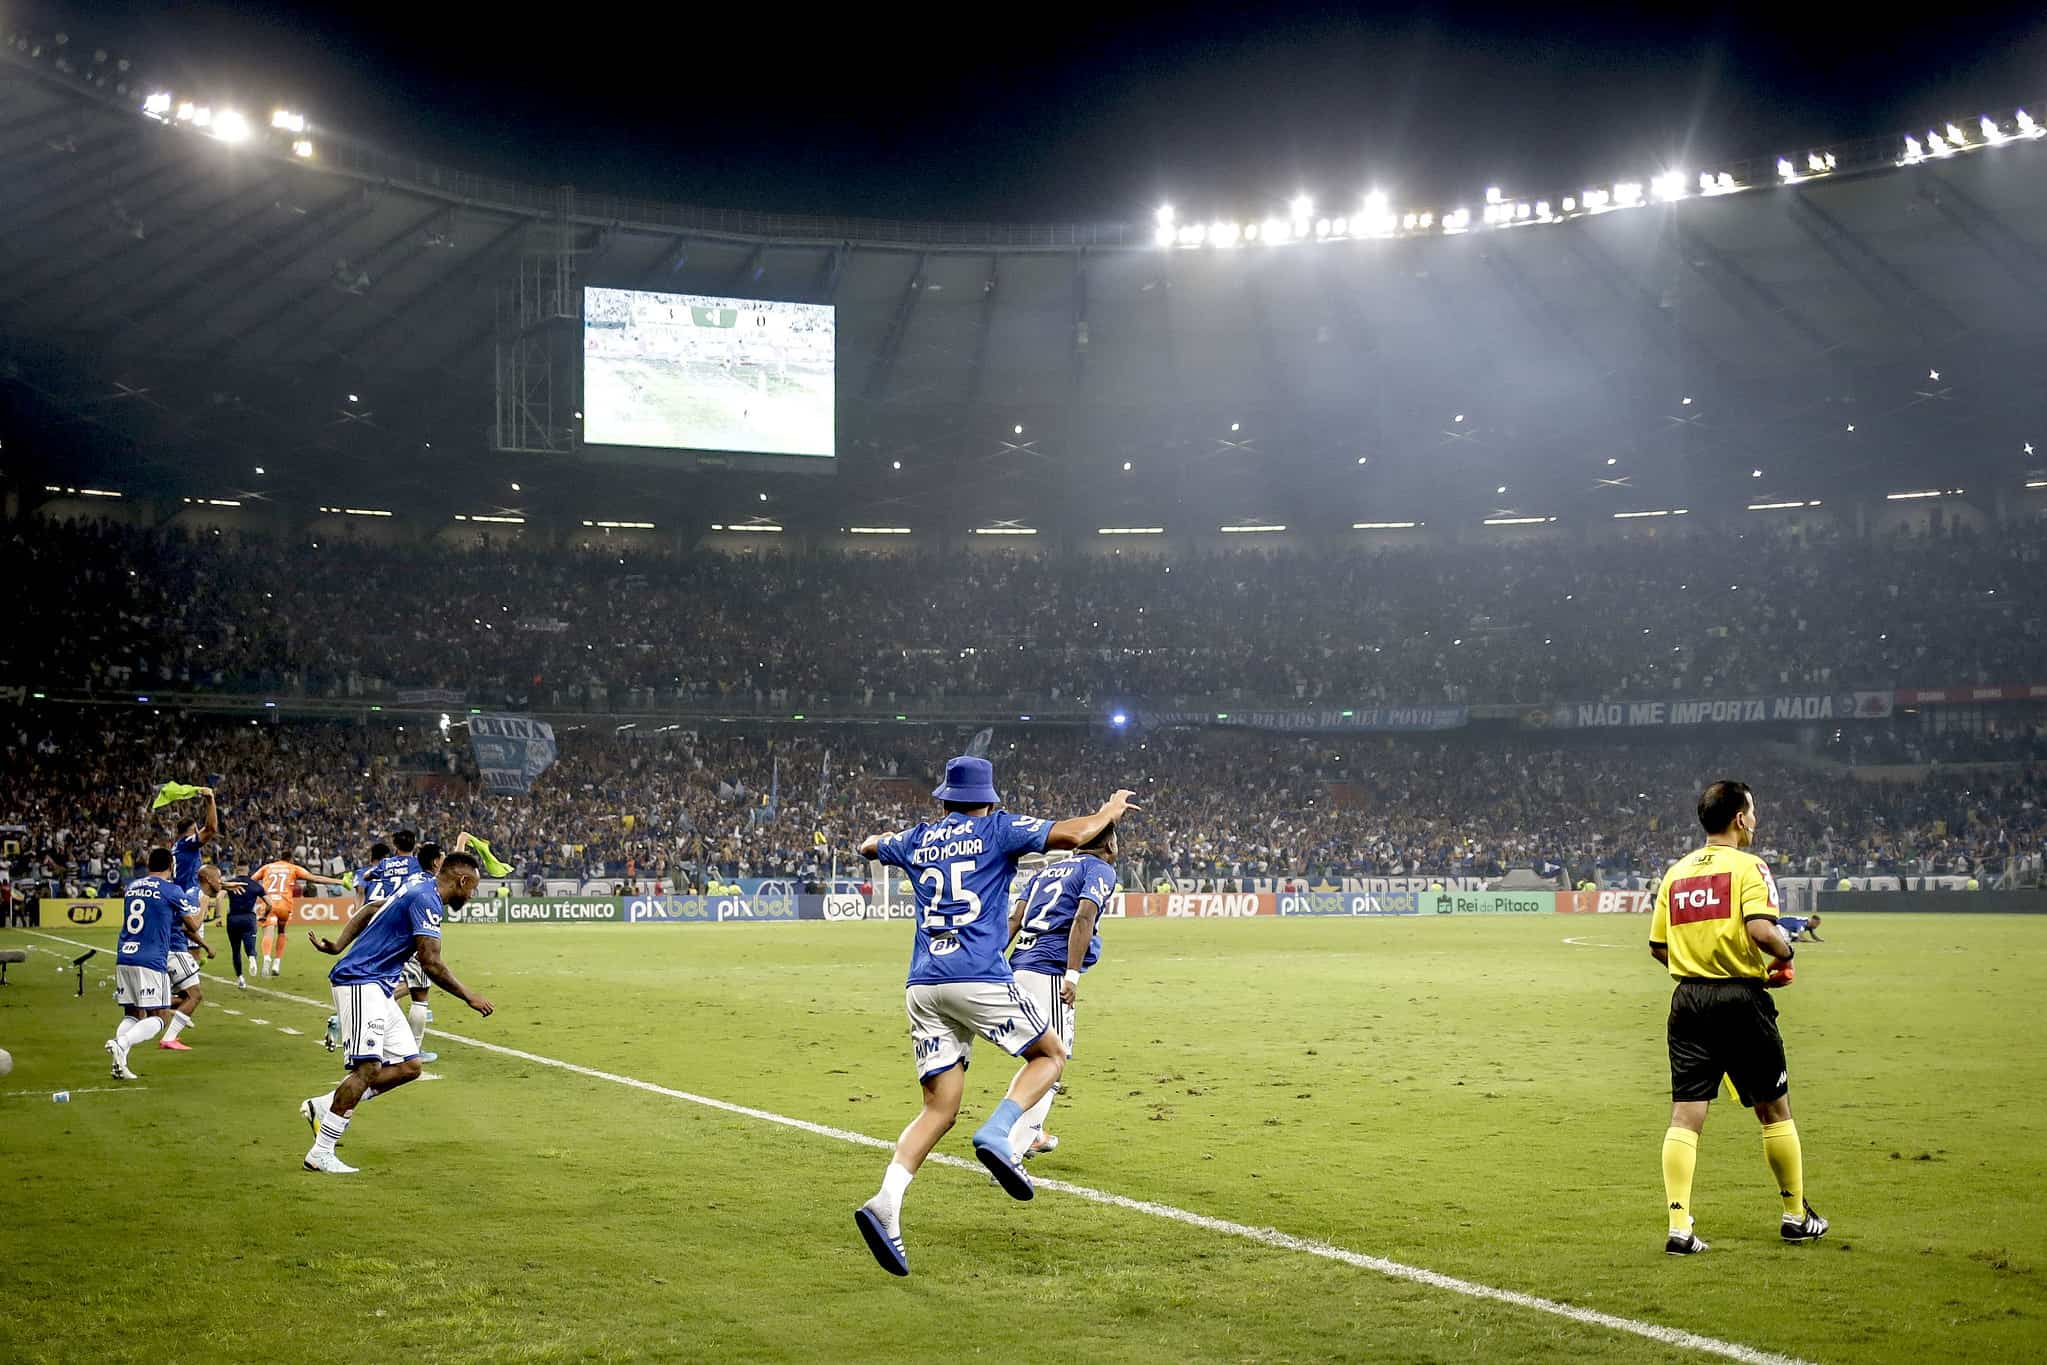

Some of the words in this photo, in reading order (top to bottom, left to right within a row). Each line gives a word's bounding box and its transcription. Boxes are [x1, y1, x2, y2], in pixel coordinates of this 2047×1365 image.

[1629, 702, 1664, 725] ME
[1670, 700, 1765, 725] IMPORTA
[1773, 696, 1833, 720] NADA
[267, 873, 289, 893] 27
[919, 859, 982, 929] 25
[300, 903, 340, 920] GOL
[510, 904, 549, 919] GRAU
[553, 900, 615, 919] TÉCNICO
[630, 896, 711, 923] pixbet
[717, 896, 793, 922] pixbet
[1021, 878, 1063, 931] 12
[1167, 893, 1260, 918] BETANO
[1281, 891, 1345, 917] pixbet
[1352, 892, 1415, 916] pixbet
[1457, 898, 1478, 912] Rei
[1495, 897, 1540, 913] Pitaco
[1674, 887, 1721, 911] TCL
[72, 907, 98, 922] BH
[126, 898, 146, 935] 8
